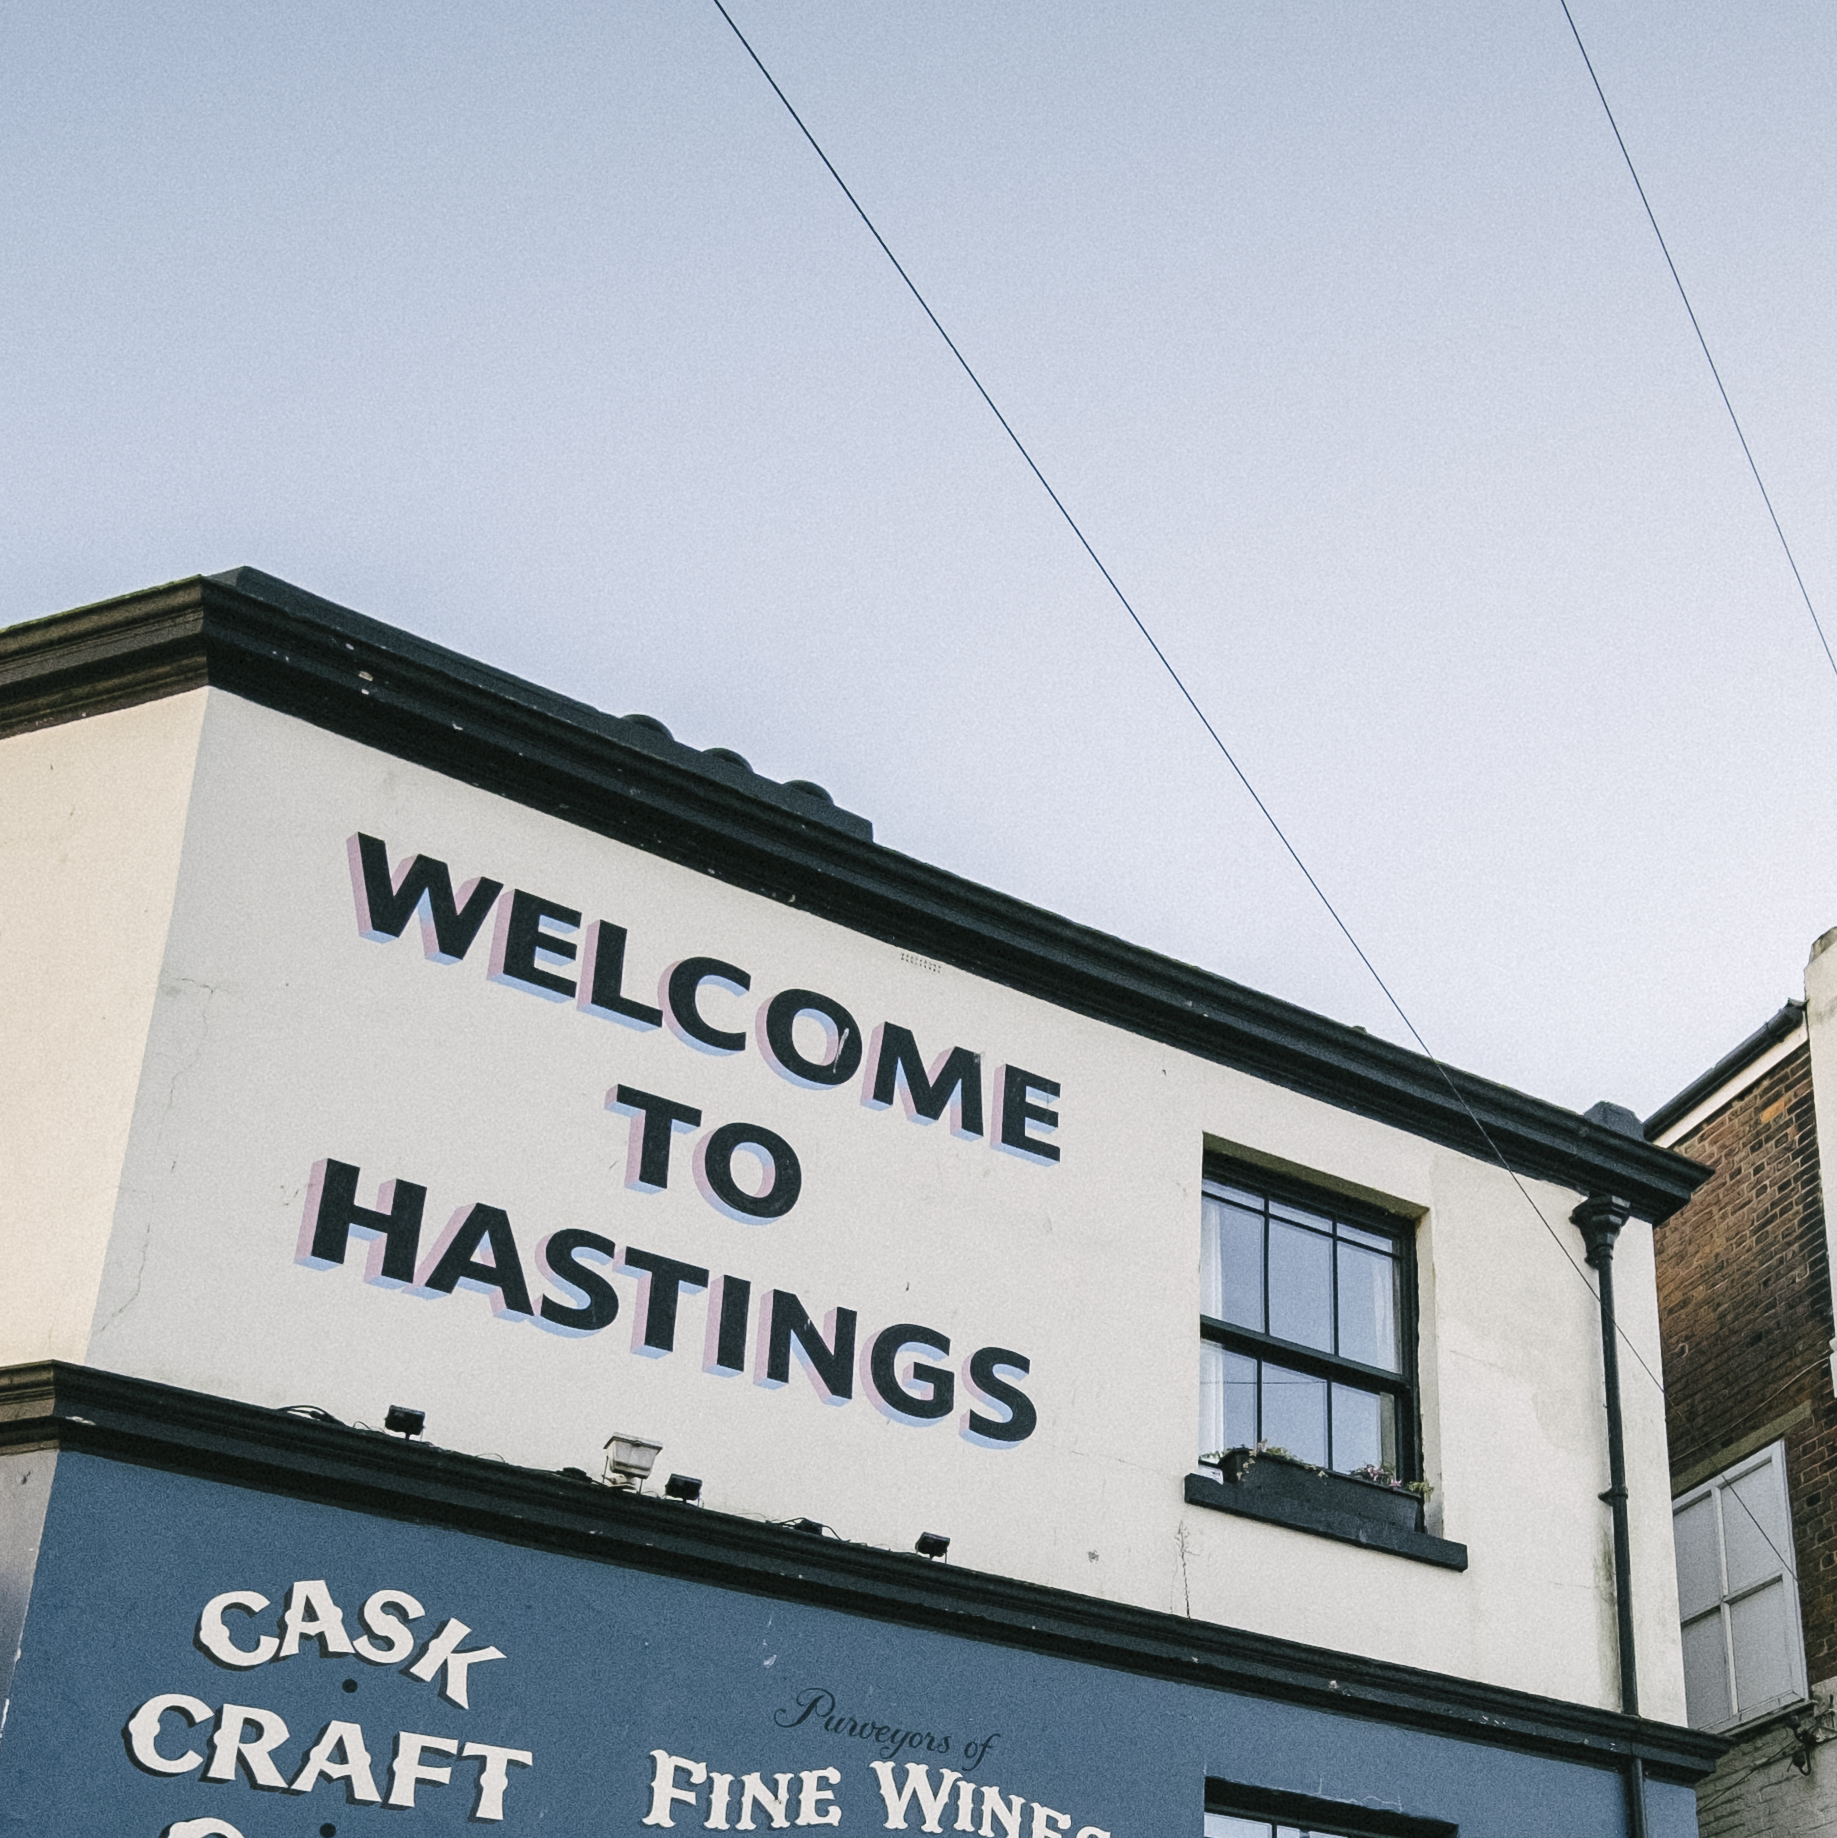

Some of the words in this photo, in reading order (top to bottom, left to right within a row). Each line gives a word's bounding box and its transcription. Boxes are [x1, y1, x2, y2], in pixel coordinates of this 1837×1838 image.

[346, 831, 1060, 1166] WELCOME
[604, 1084, 802, 1225] TO
[294, 1158, 1037, 1449] HASTINGS
[193, 1580, 507, 1709] CASK
[121, 1693, 533, 1823] CRAFT
[642, 1750, 843, 1830] FINE
[774, 1688, 952, 1758] Purveyors
[962, 1734, 1001, 1771] of
